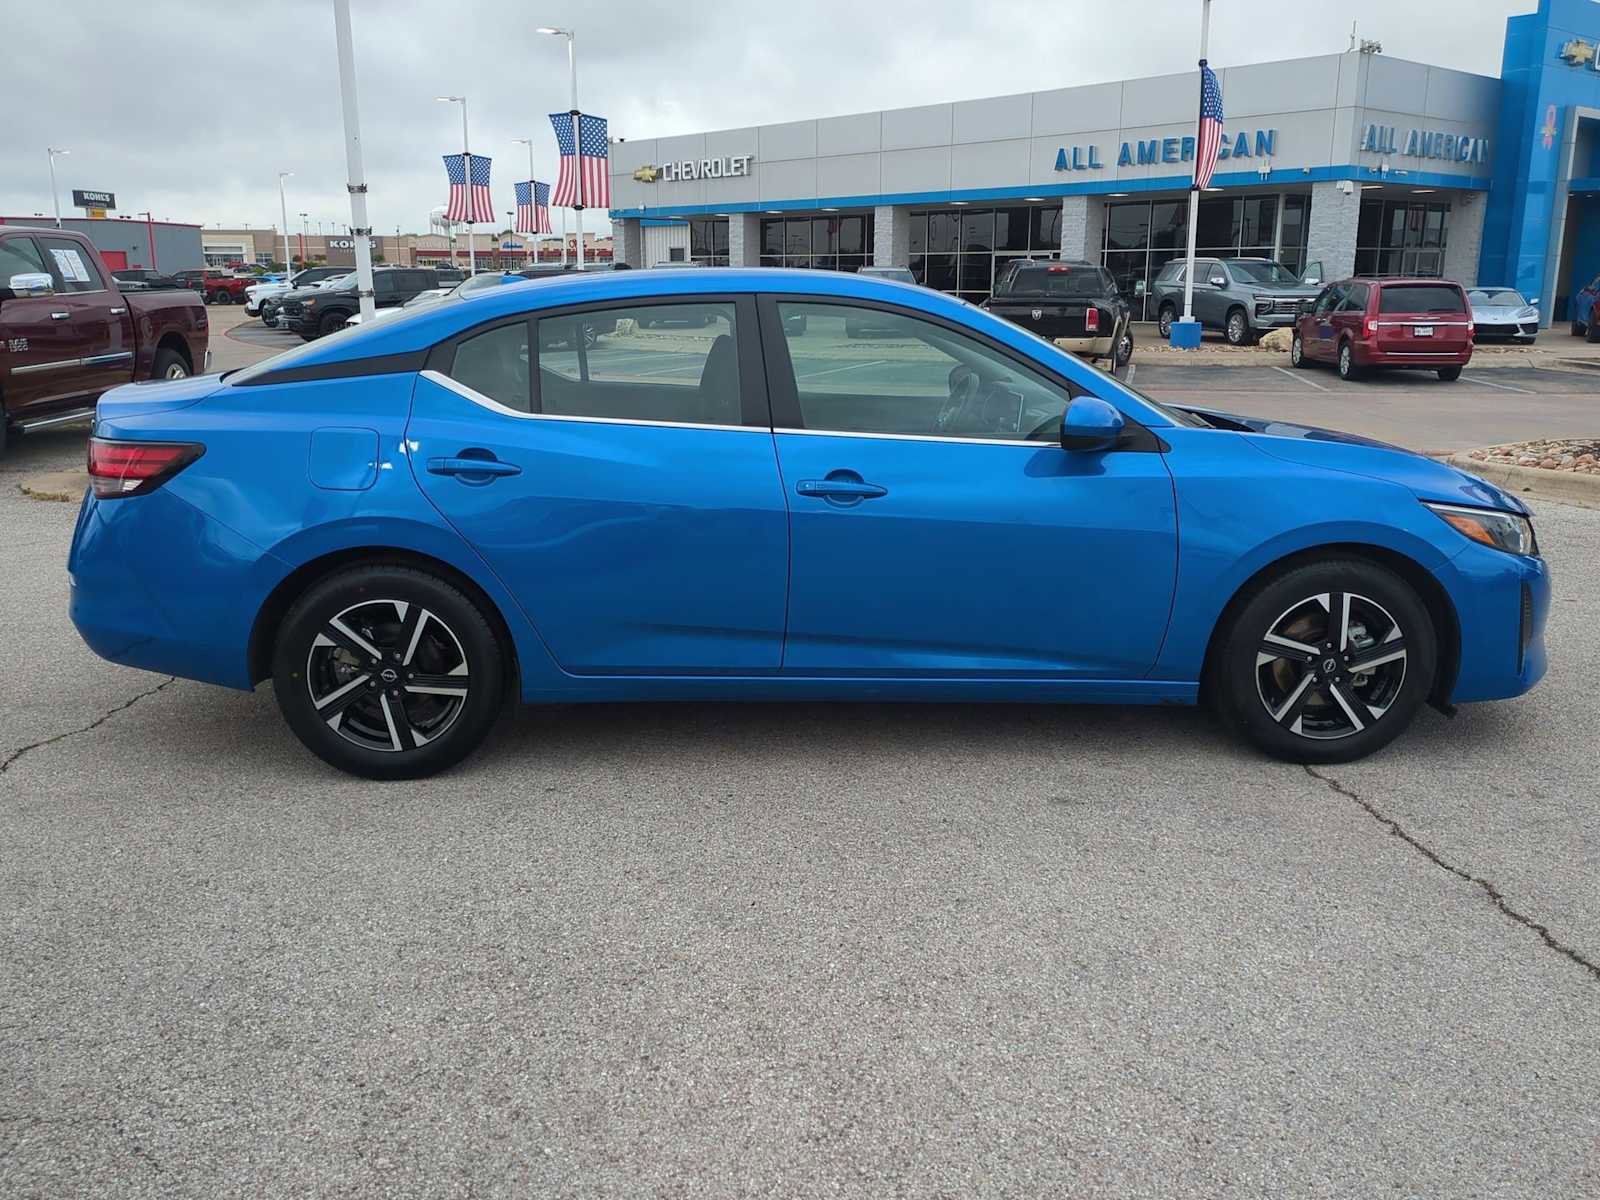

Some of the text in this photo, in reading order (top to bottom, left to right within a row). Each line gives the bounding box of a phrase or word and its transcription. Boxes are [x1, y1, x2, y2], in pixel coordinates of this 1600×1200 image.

[1054, 129, 1276, 171] ALL AMERCAN
[1362, 124, 1397, 154] ALL
[662, 155, 752, 182] CHEVROLET
